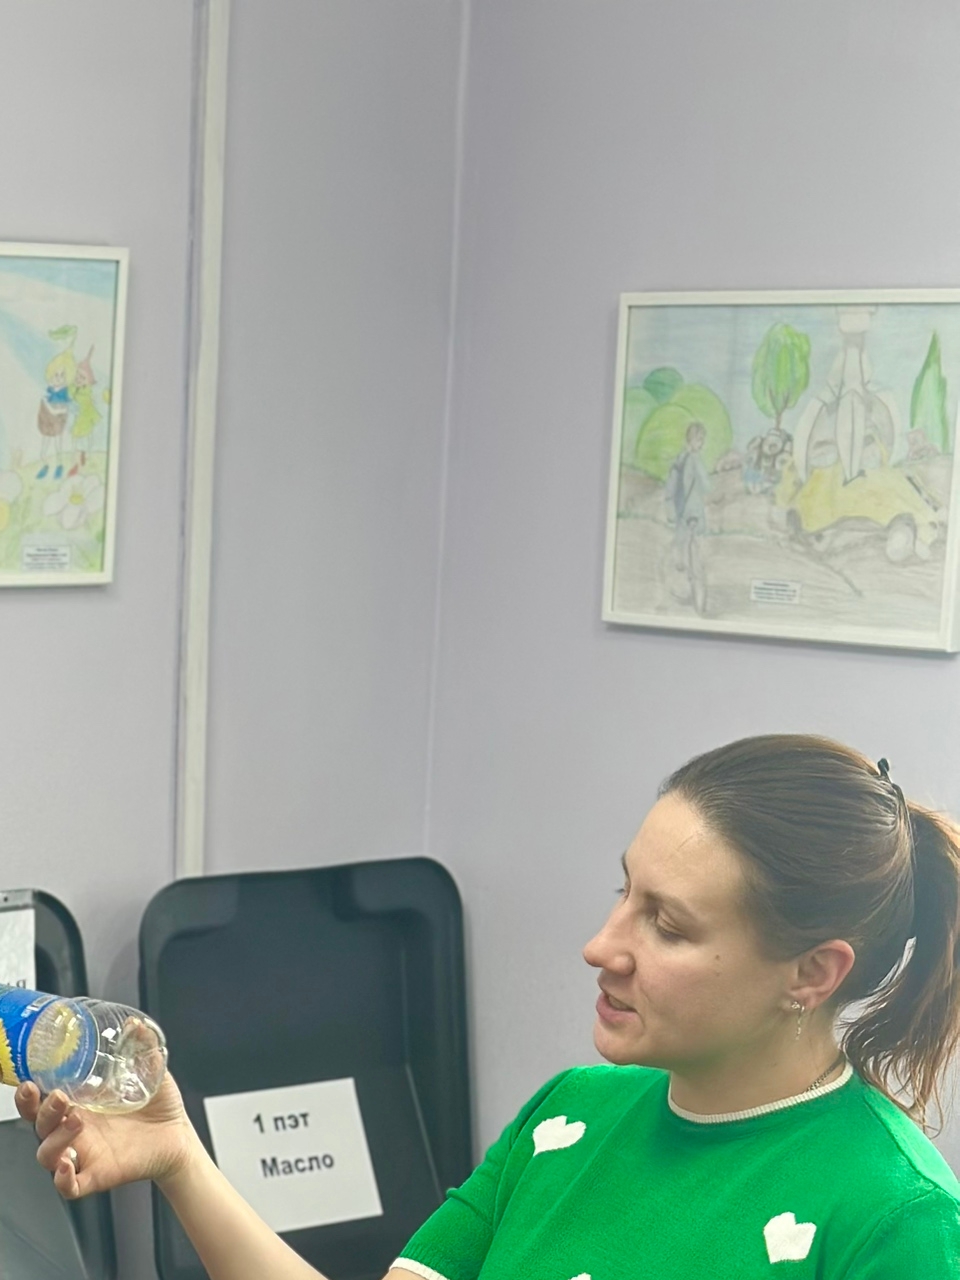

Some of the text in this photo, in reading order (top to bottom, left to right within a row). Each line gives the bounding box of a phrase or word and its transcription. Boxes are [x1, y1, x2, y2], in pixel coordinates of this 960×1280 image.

[253, 1112, 309, 1134] 1 пэт
[260, 1153, 335, 1179] Масло
